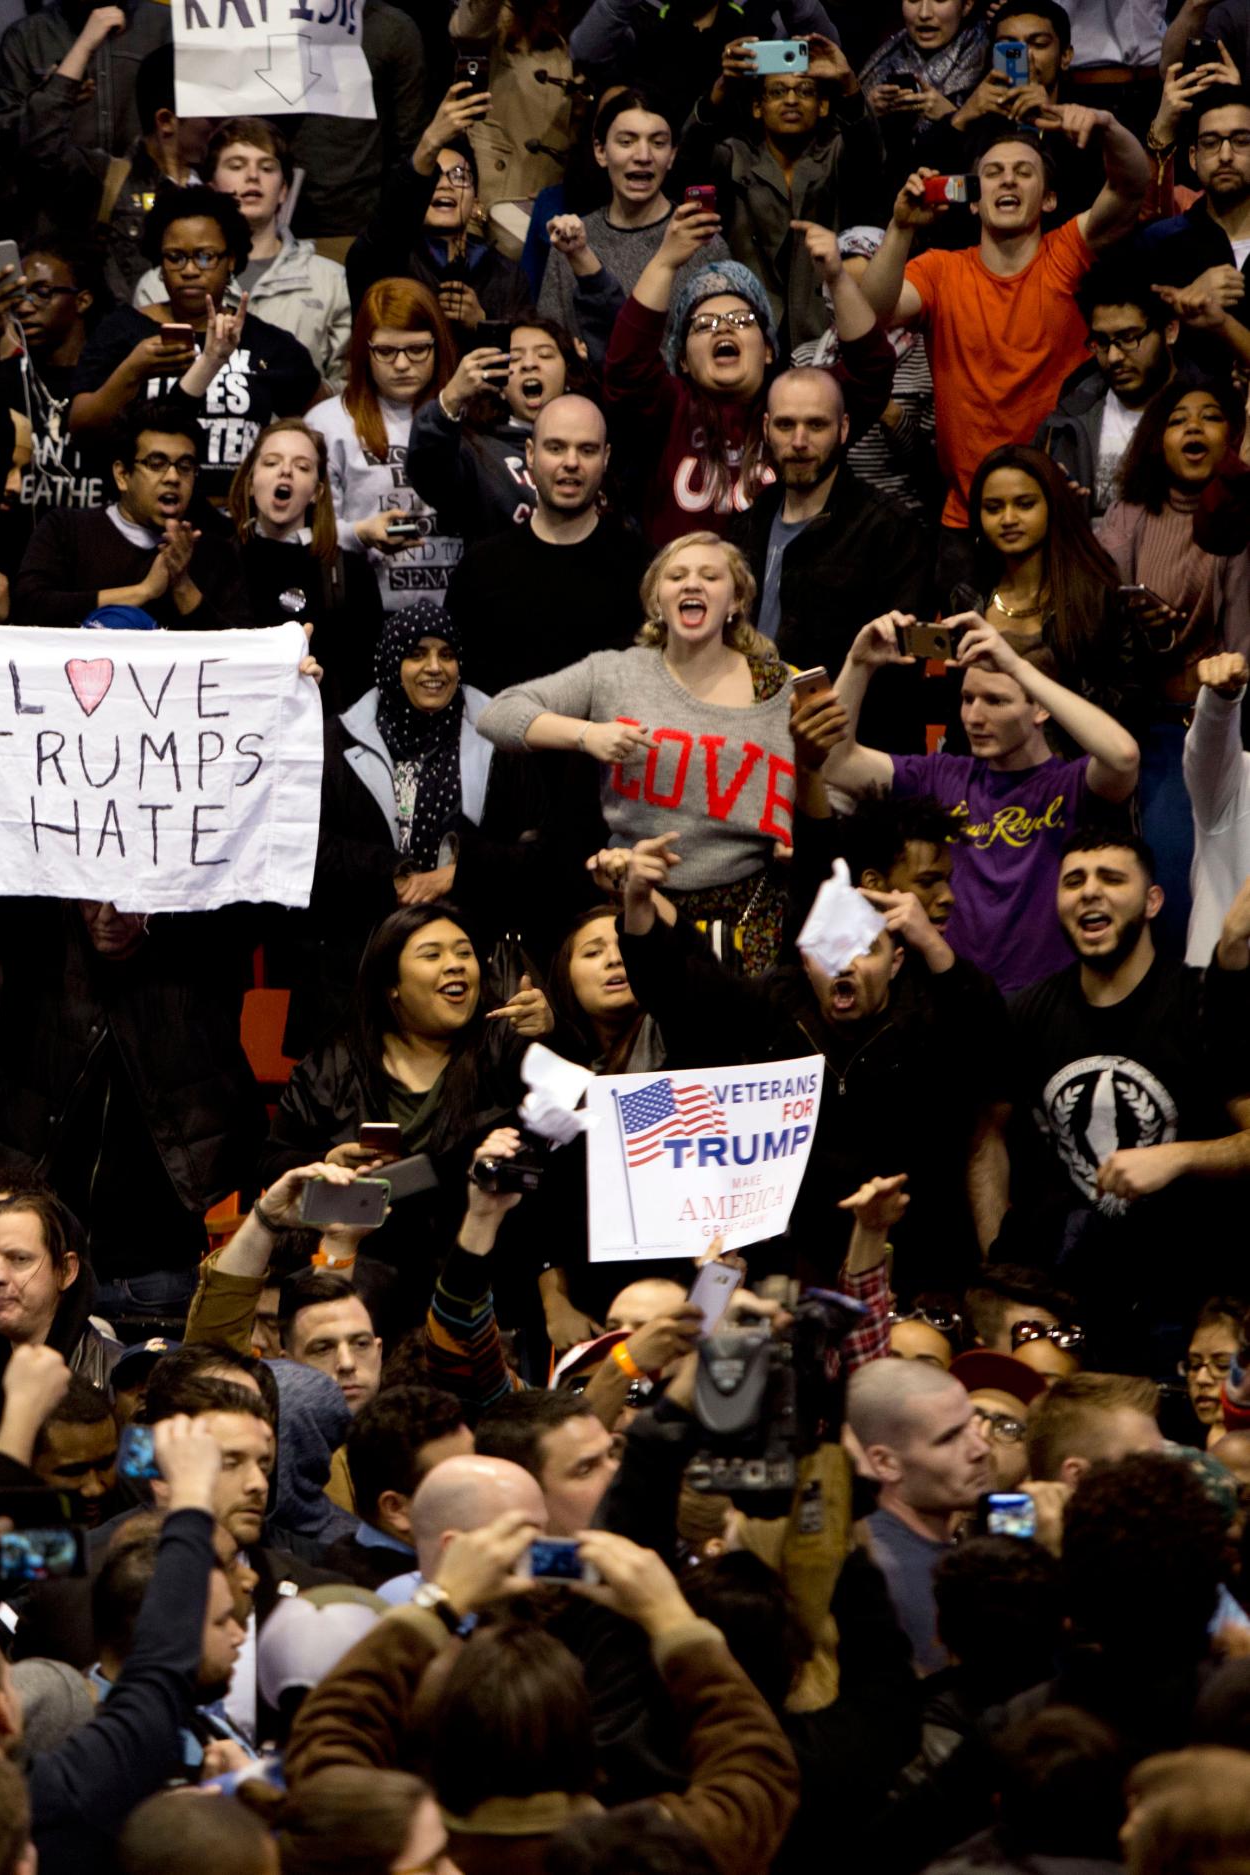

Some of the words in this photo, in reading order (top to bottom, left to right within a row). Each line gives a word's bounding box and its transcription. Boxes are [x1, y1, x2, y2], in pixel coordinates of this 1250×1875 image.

[31, 796, 230, 866] HATE
[713, 1073, 818, 1105] VETERANS
[782, 1098, 814, 1122] FOR
[663, 1124, 812, 1168] TRUMP
[731, 1174, 762, 1188] MAKE
[678, 1185, 785, 1221] AMERICA
